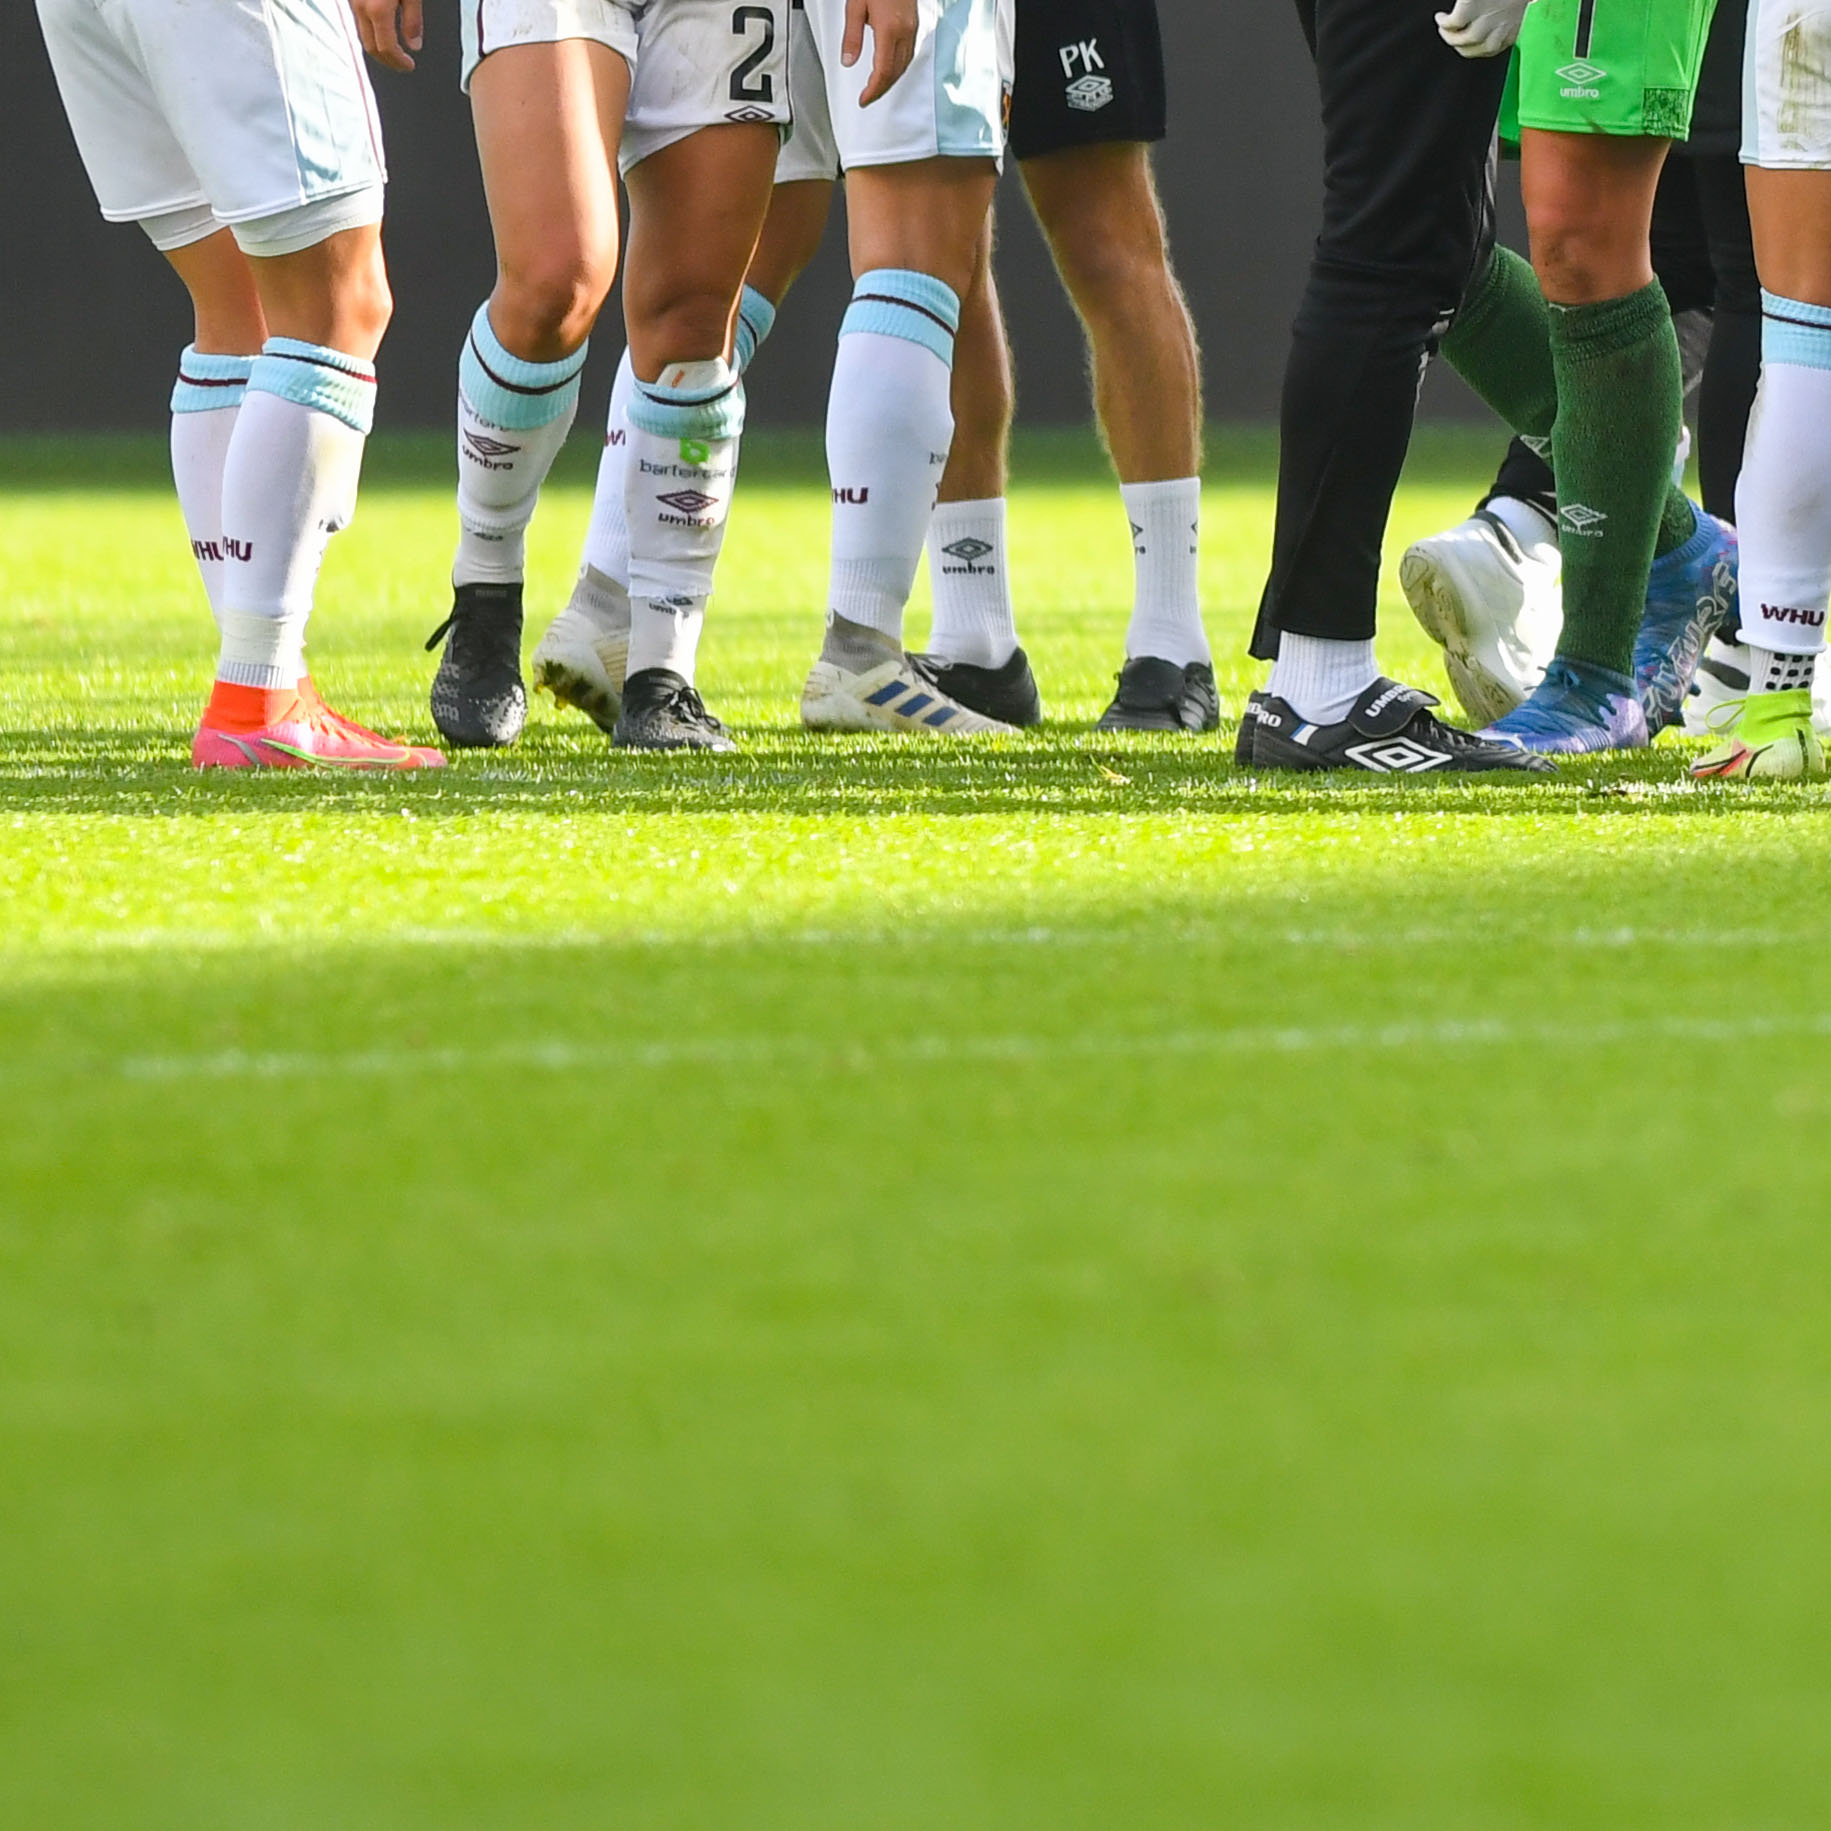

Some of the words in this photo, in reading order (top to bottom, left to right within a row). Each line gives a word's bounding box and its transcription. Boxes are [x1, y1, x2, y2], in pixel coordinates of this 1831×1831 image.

[729, 5, 774, 105] 2
[1059, 37, 1105, 79] PK
[1560, 86, 1600, 99] umbro
[461, 444, 514, 471] umbro
[832, 487, 869, 505] HU
[658, 513, 715, 527] umbro
[223, 536, 253, 562] HU
[942, 562, 996, 576] umbro
[1761, 603, 1825, 627] WHU
